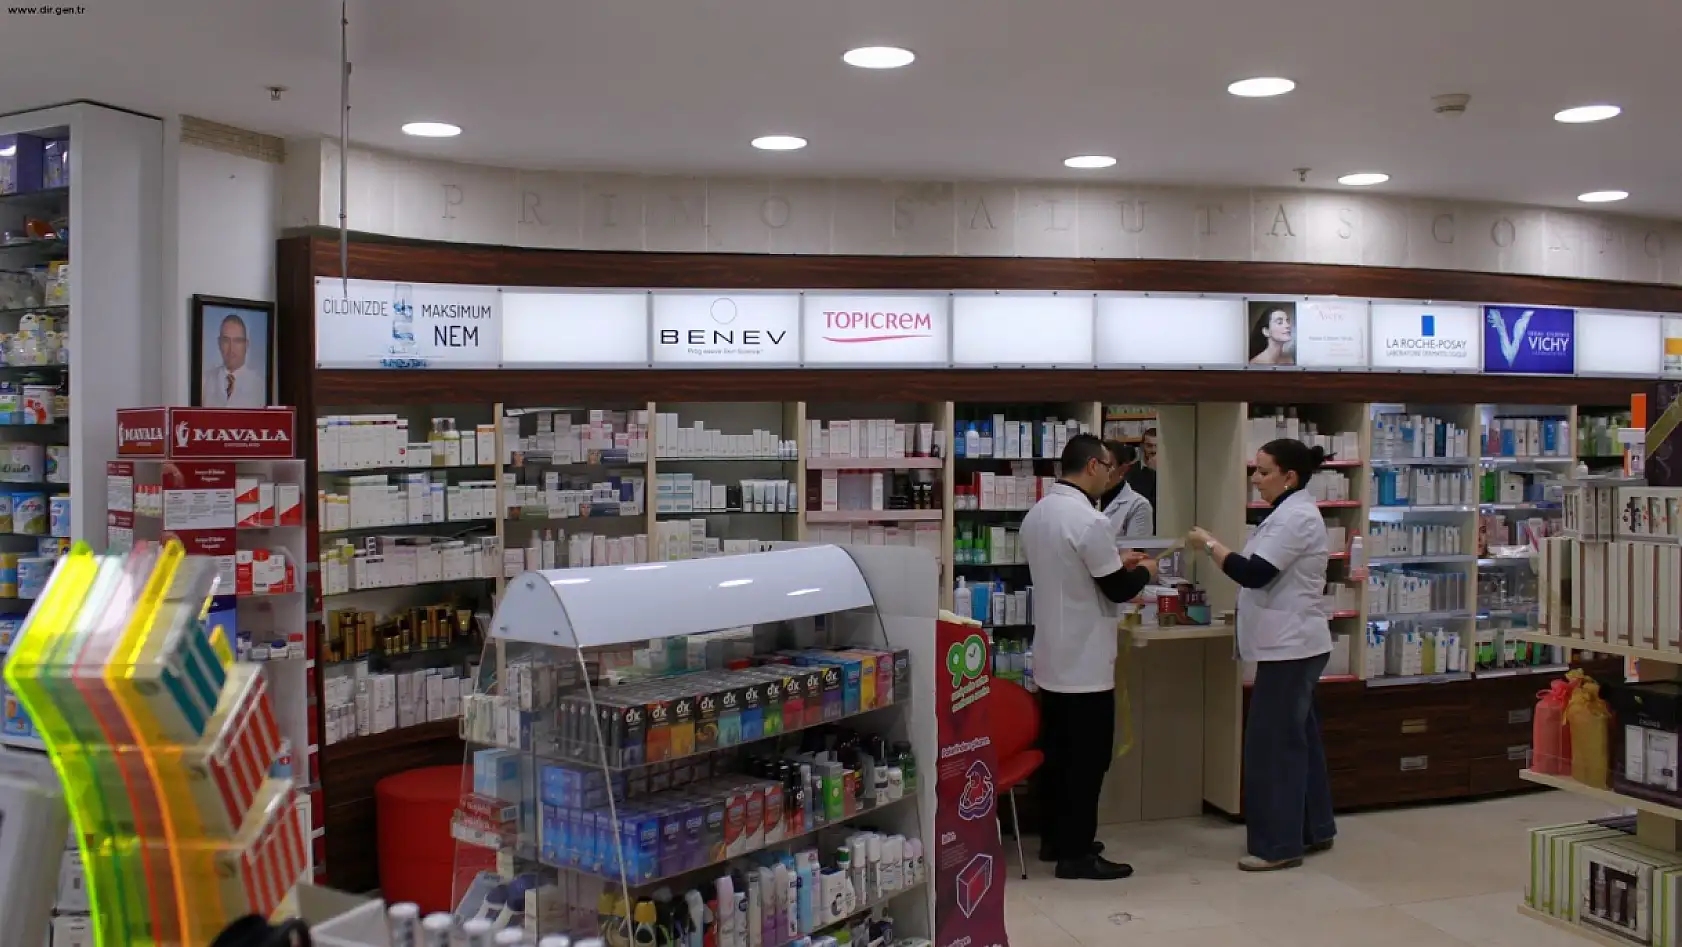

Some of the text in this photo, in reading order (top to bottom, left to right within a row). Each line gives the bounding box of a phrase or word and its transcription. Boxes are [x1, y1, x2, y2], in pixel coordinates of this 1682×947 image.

[434, 325, 479, 347] NEM
[660, 329, 787, 345] BENEV
[1386, 338, 1467, 350] LA ROCHE-POSAY
[1528, 336, 1570, 351] VICHY
[125, 427, 164, 441] MAVALA
[193, 428, 290, 441] MAVALA
